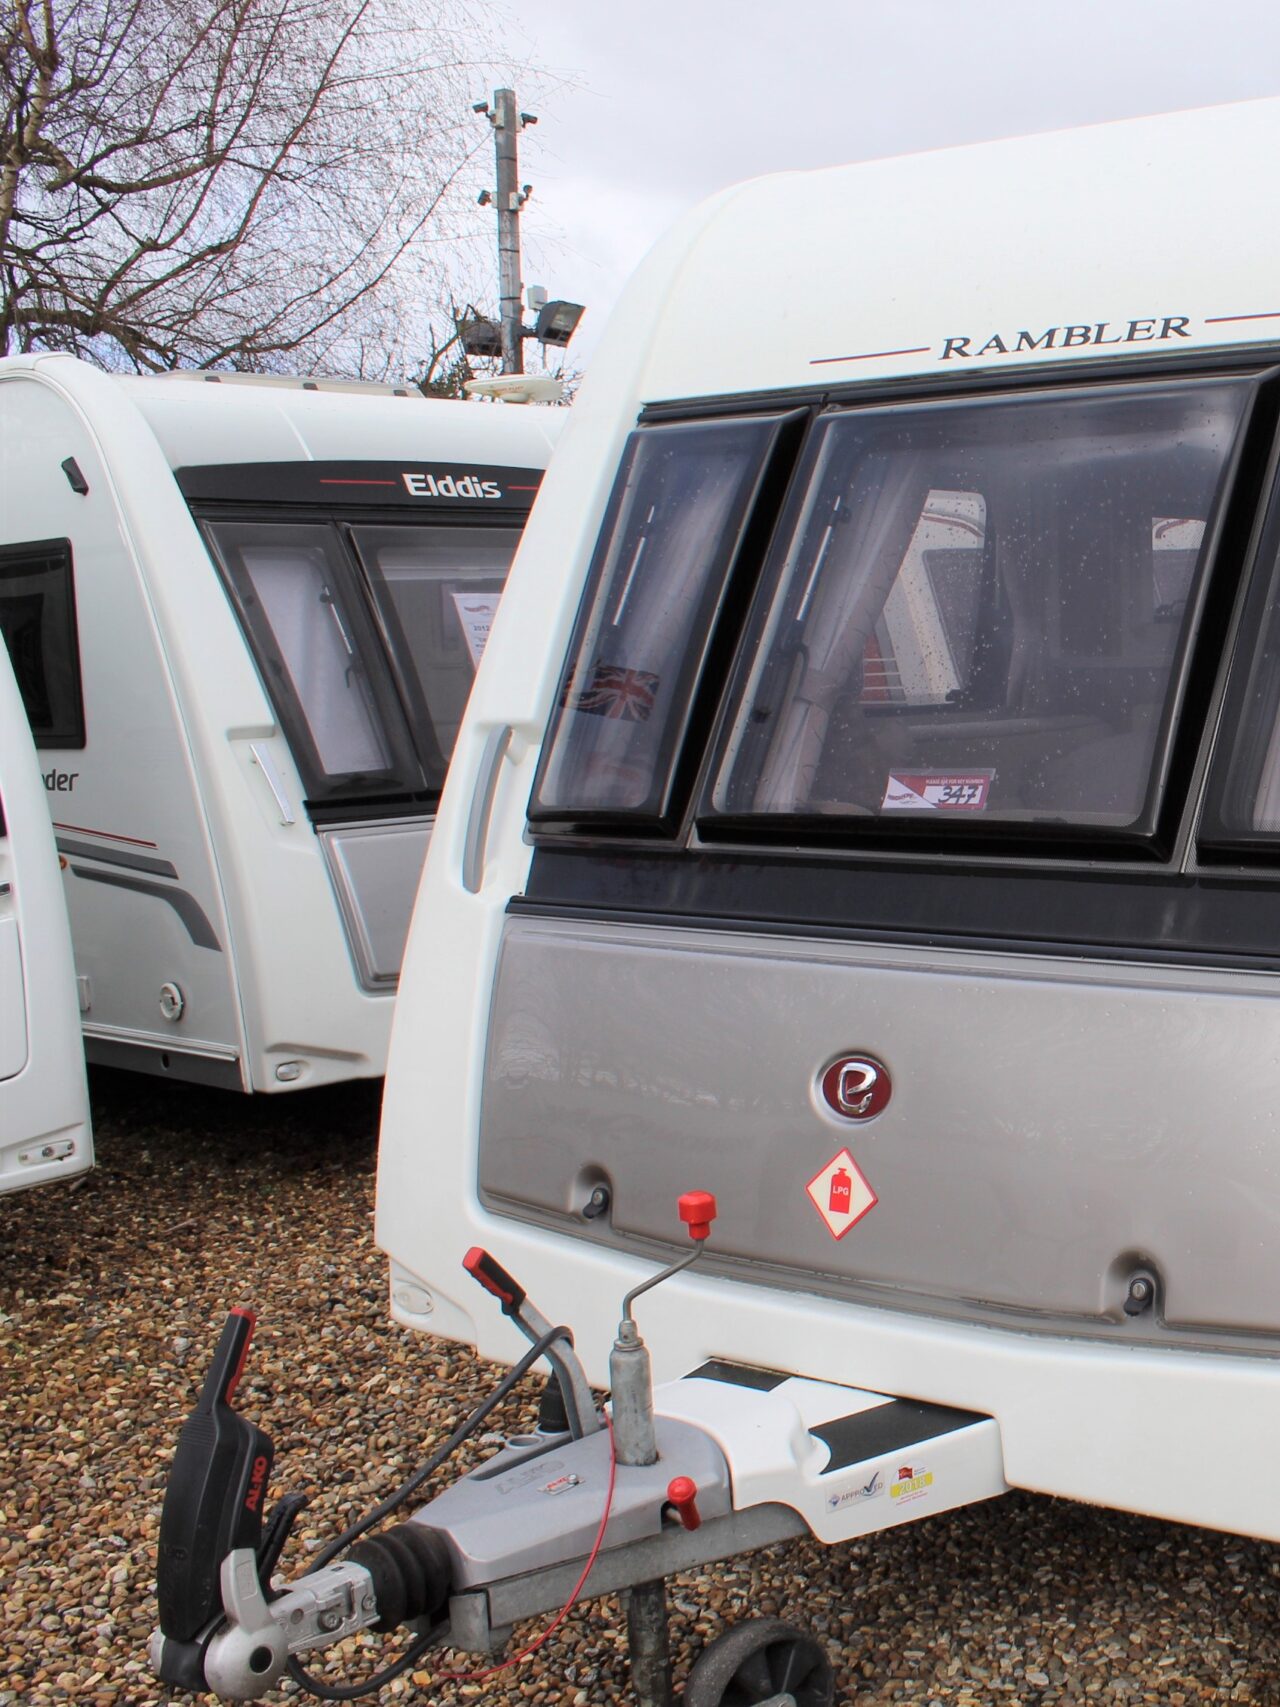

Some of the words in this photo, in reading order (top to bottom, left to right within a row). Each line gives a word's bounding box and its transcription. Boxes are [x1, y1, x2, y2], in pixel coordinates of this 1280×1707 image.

[938, 316, 1192, 360] RAMBLER
[401, 473, 502, 499] Elddis
[938, 784, 979, 805] 347
[832, 1185, 849, 1196] LPG
[244, 1456, 268, 1512] AL-KO
